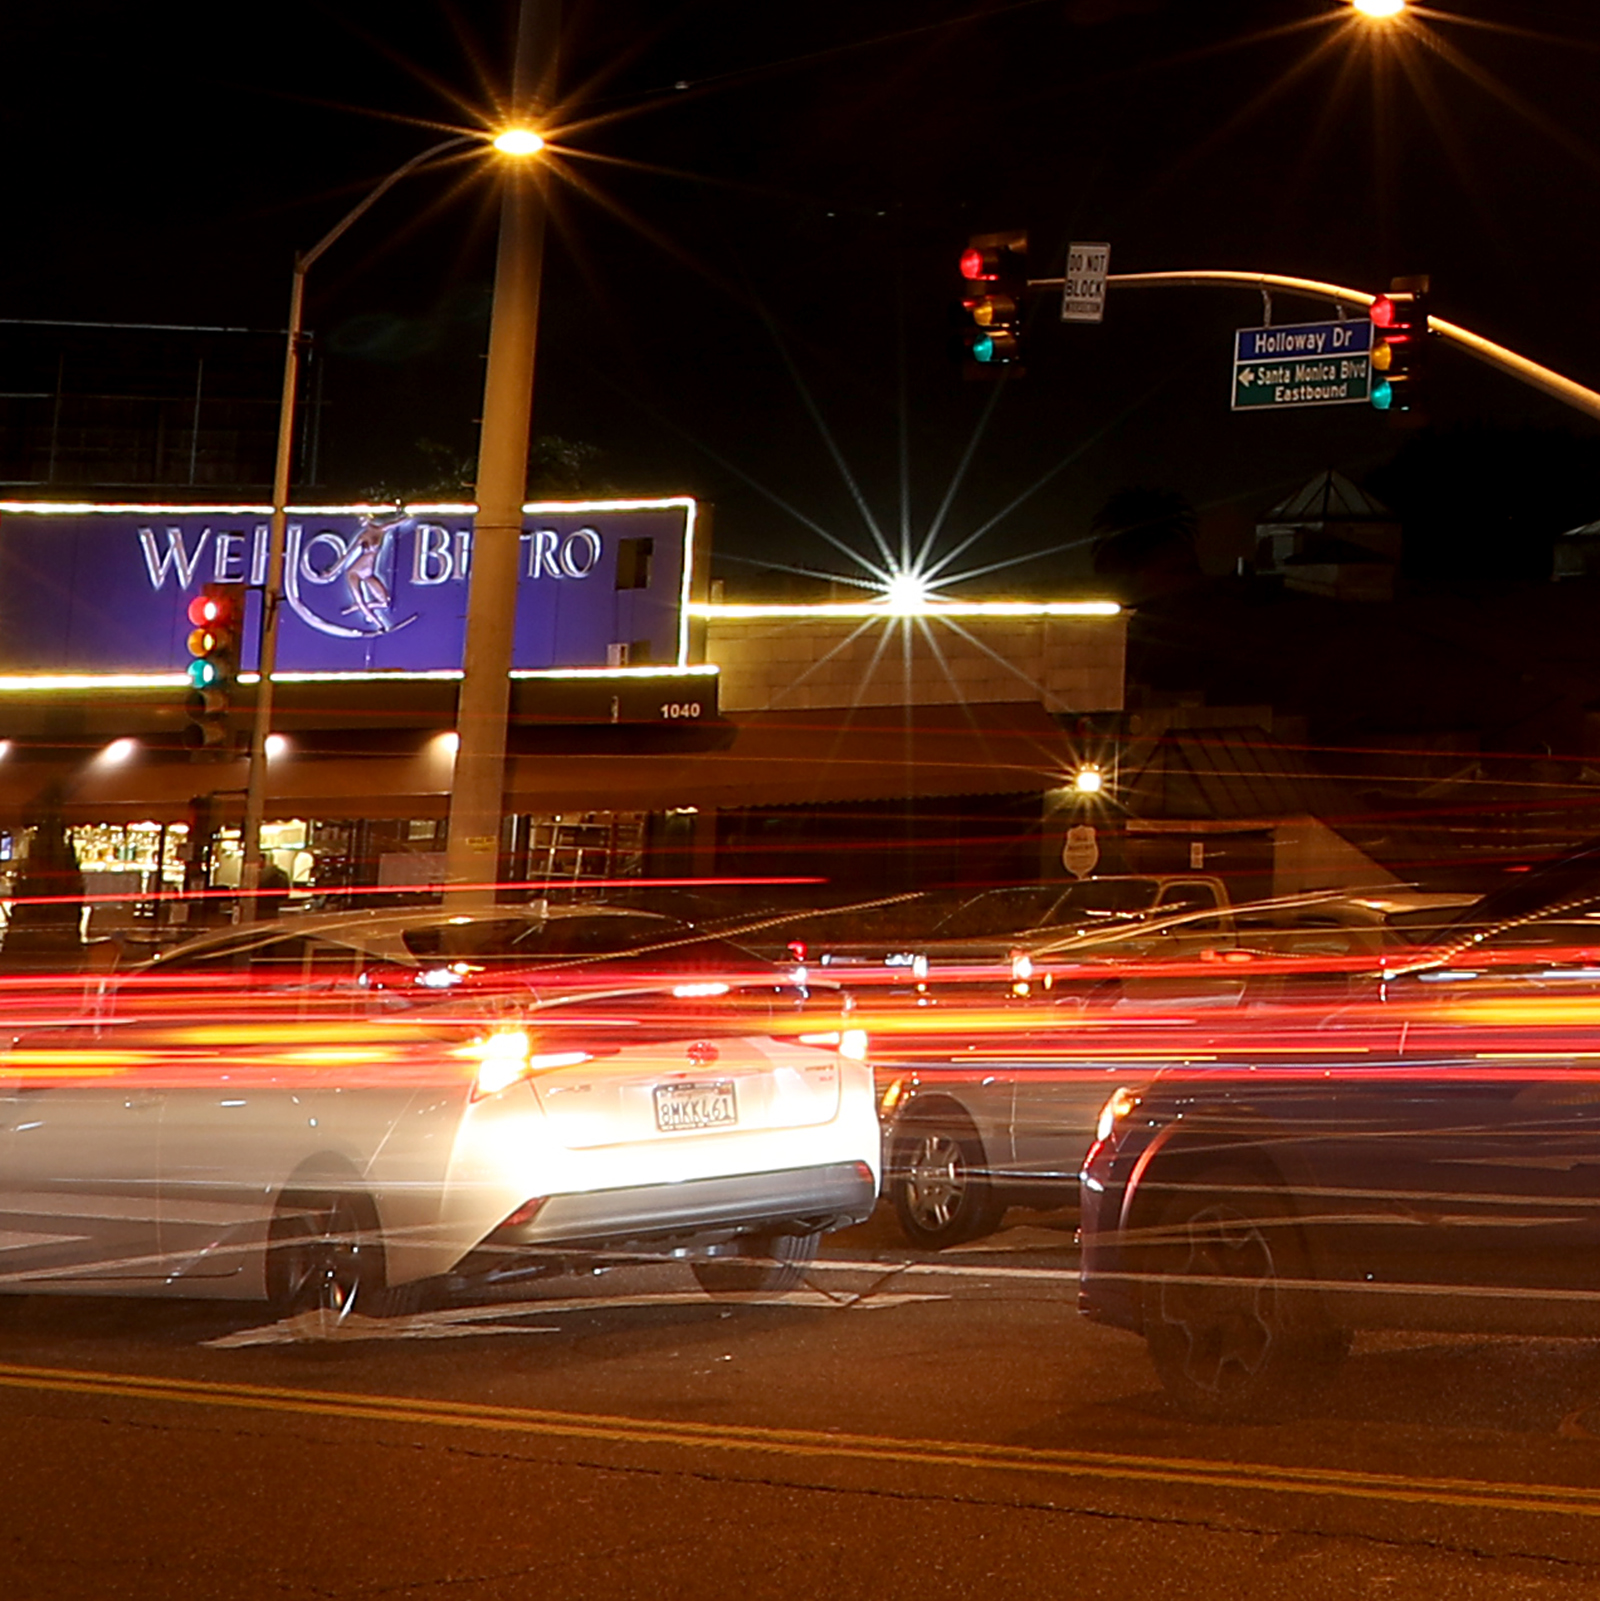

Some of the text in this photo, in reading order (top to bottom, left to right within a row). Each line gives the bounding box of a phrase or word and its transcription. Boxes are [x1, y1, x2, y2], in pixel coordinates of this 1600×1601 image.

[1069, 254, 1105, 272] DO NOT
[1066, 279, 1102, 298] BLOCK
[1254, 327, 1353, 354] Holloway Dr
[1257, 359, 1367, 386] Santa Monica Blvd
[1274, 382, 1348, 402] Eastbound
[661, 703, 700, 718] 1040
[661, 1098, 731, 1126] 8MKK461
